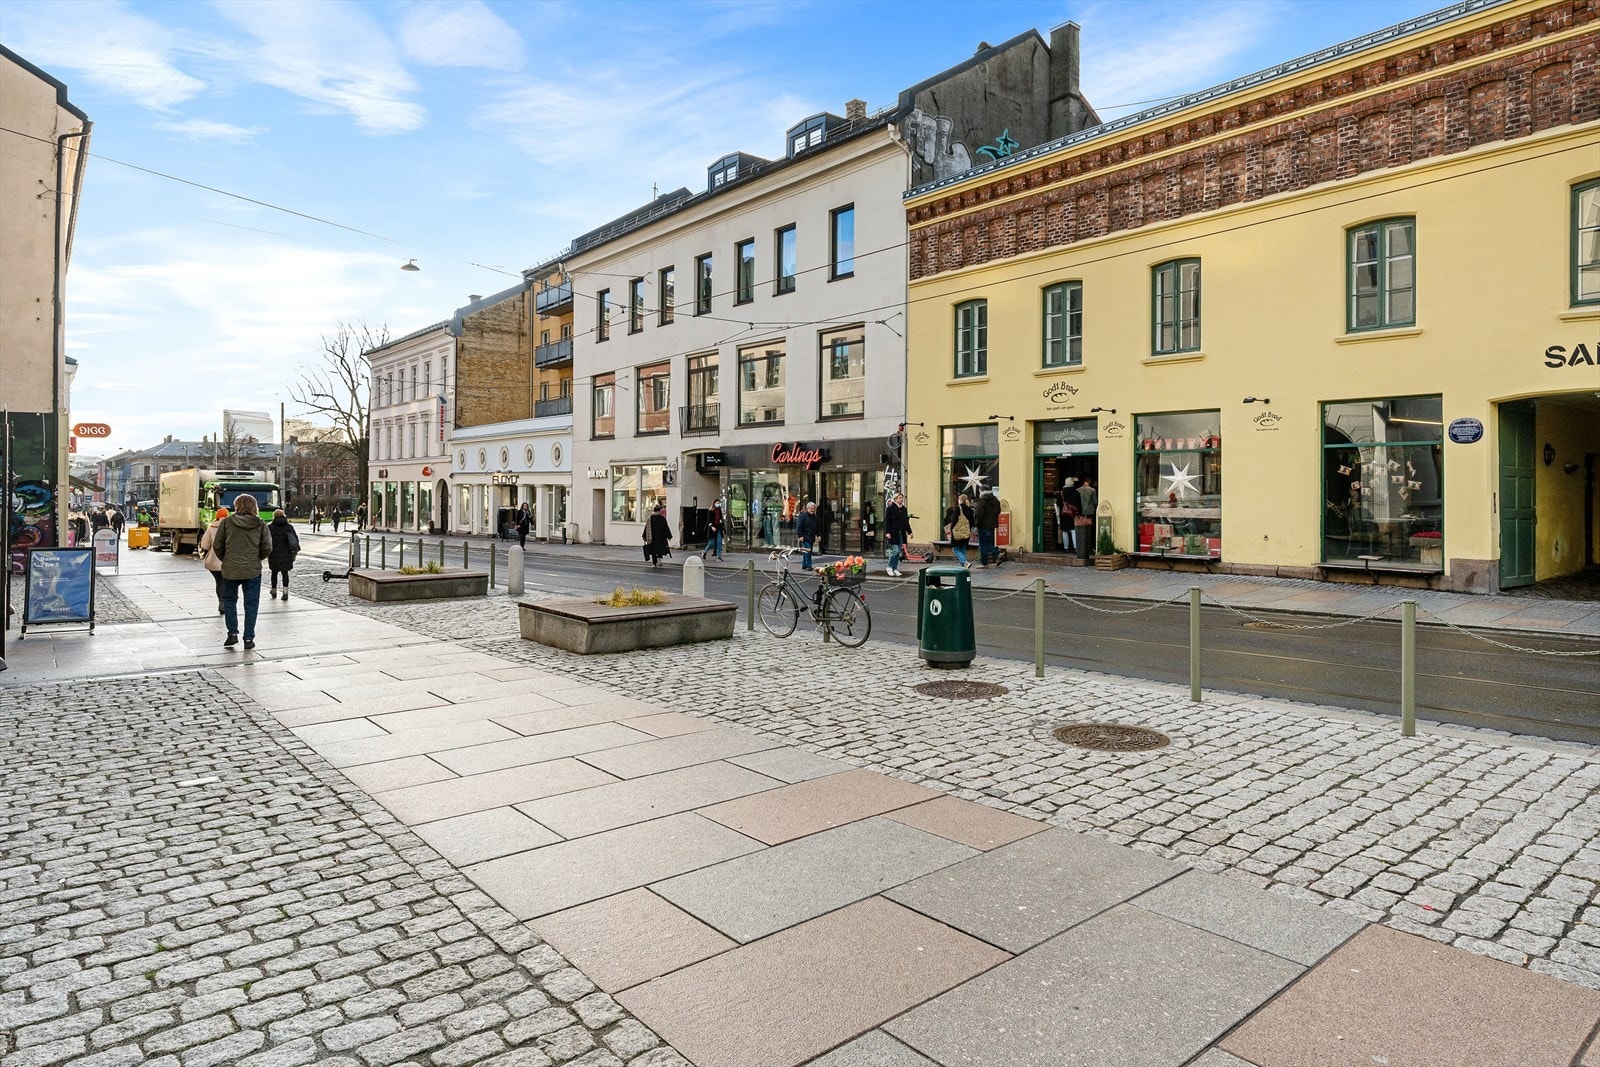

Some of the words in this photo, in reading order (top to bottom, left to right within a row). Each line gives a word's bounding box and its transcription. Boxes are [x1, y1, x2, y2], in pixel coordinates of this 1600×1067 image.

[1544, 342, 1600, 369] SA
[1043, 382, 1060, 398] Godt
[1061, 381, 1079, 395] Brød
[79, 426, 106, 436] DIGG
[771, 441, 822, 470] Carlings
